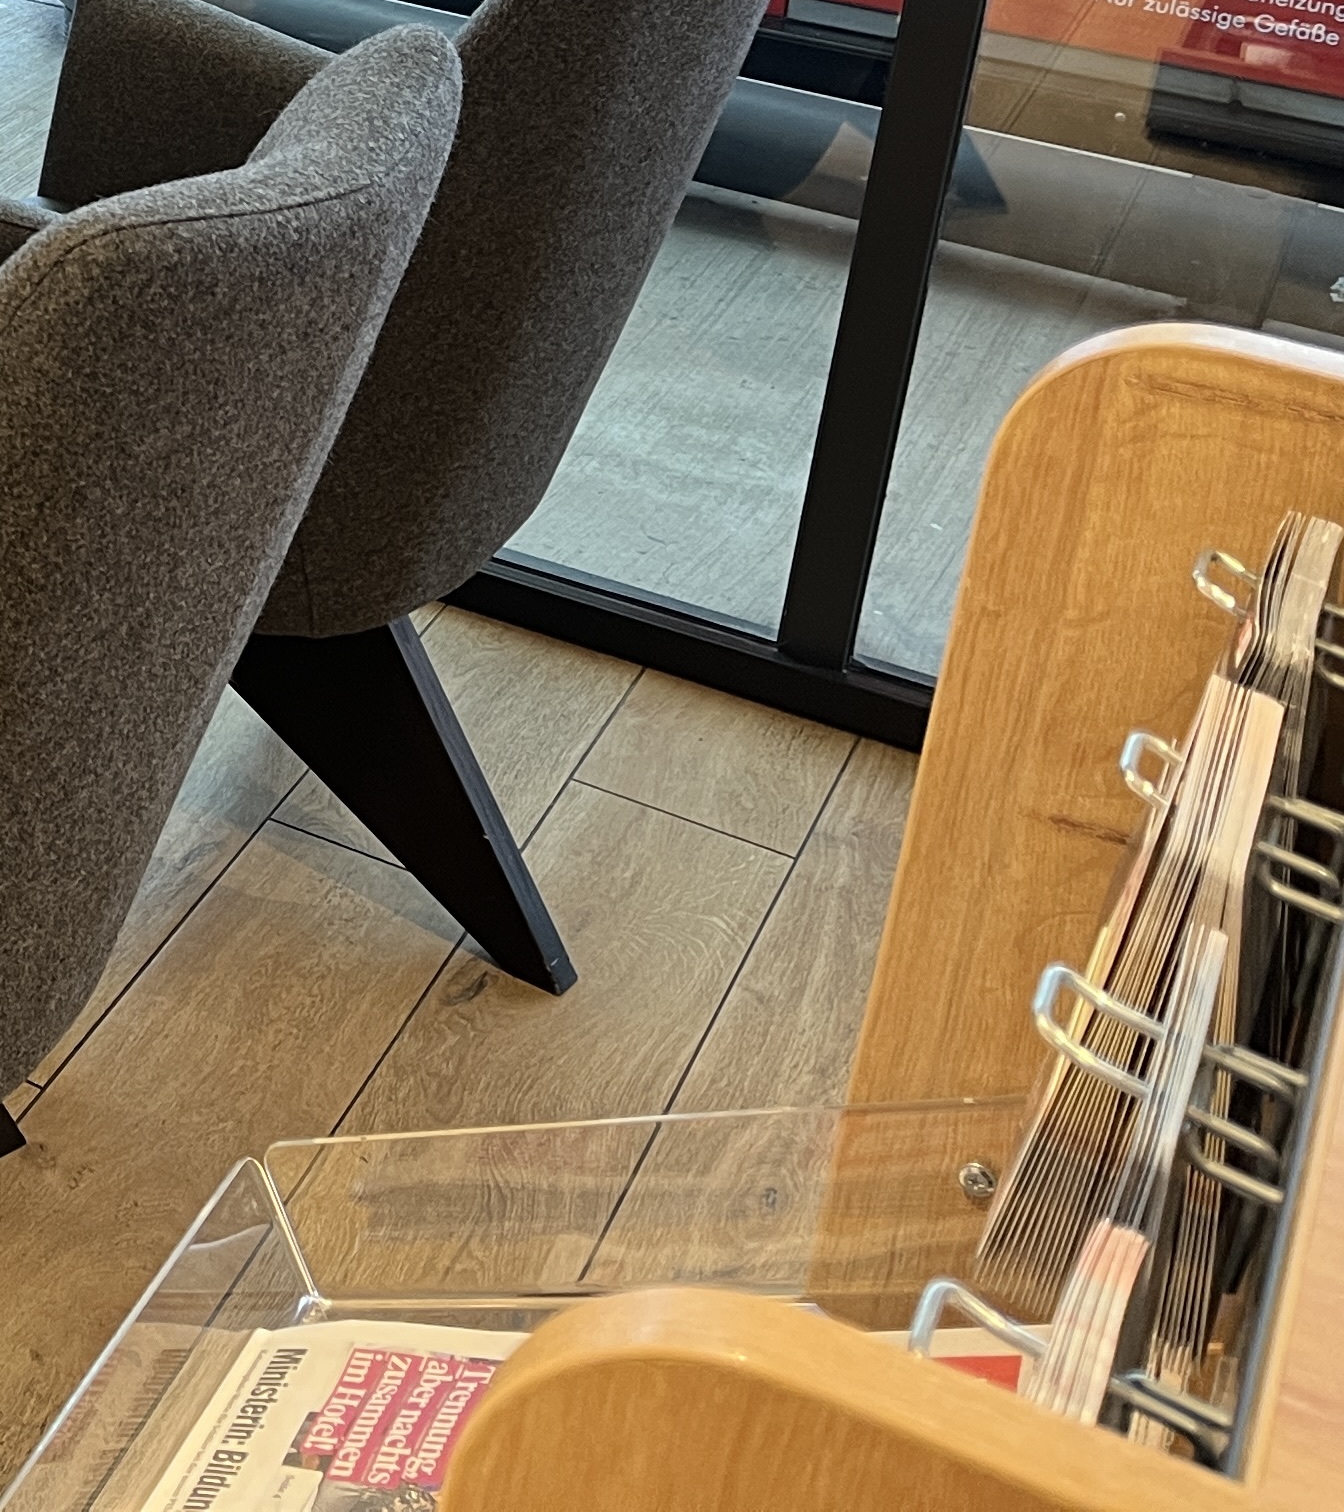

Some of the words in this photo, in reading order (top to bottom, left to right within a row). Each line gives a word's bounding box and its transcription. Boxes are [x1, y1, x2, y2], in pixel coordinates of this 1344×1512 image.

[1254, 14, 1340, 46] Gefäße
[226, 1348, 309, 1448] Ministerin:
[344, 1349, 384, 1381] im
[408, 1358, 449, 1409] aber
[305, 1385, 365, 1451] Hotel!
[331, 1354, 412, 1478] zusammen
[368, 1410, 416, 1485] nachts
[401, 1360, 496, 1480] Trennung,
[183, 1450, 247, 1512] Bildun
